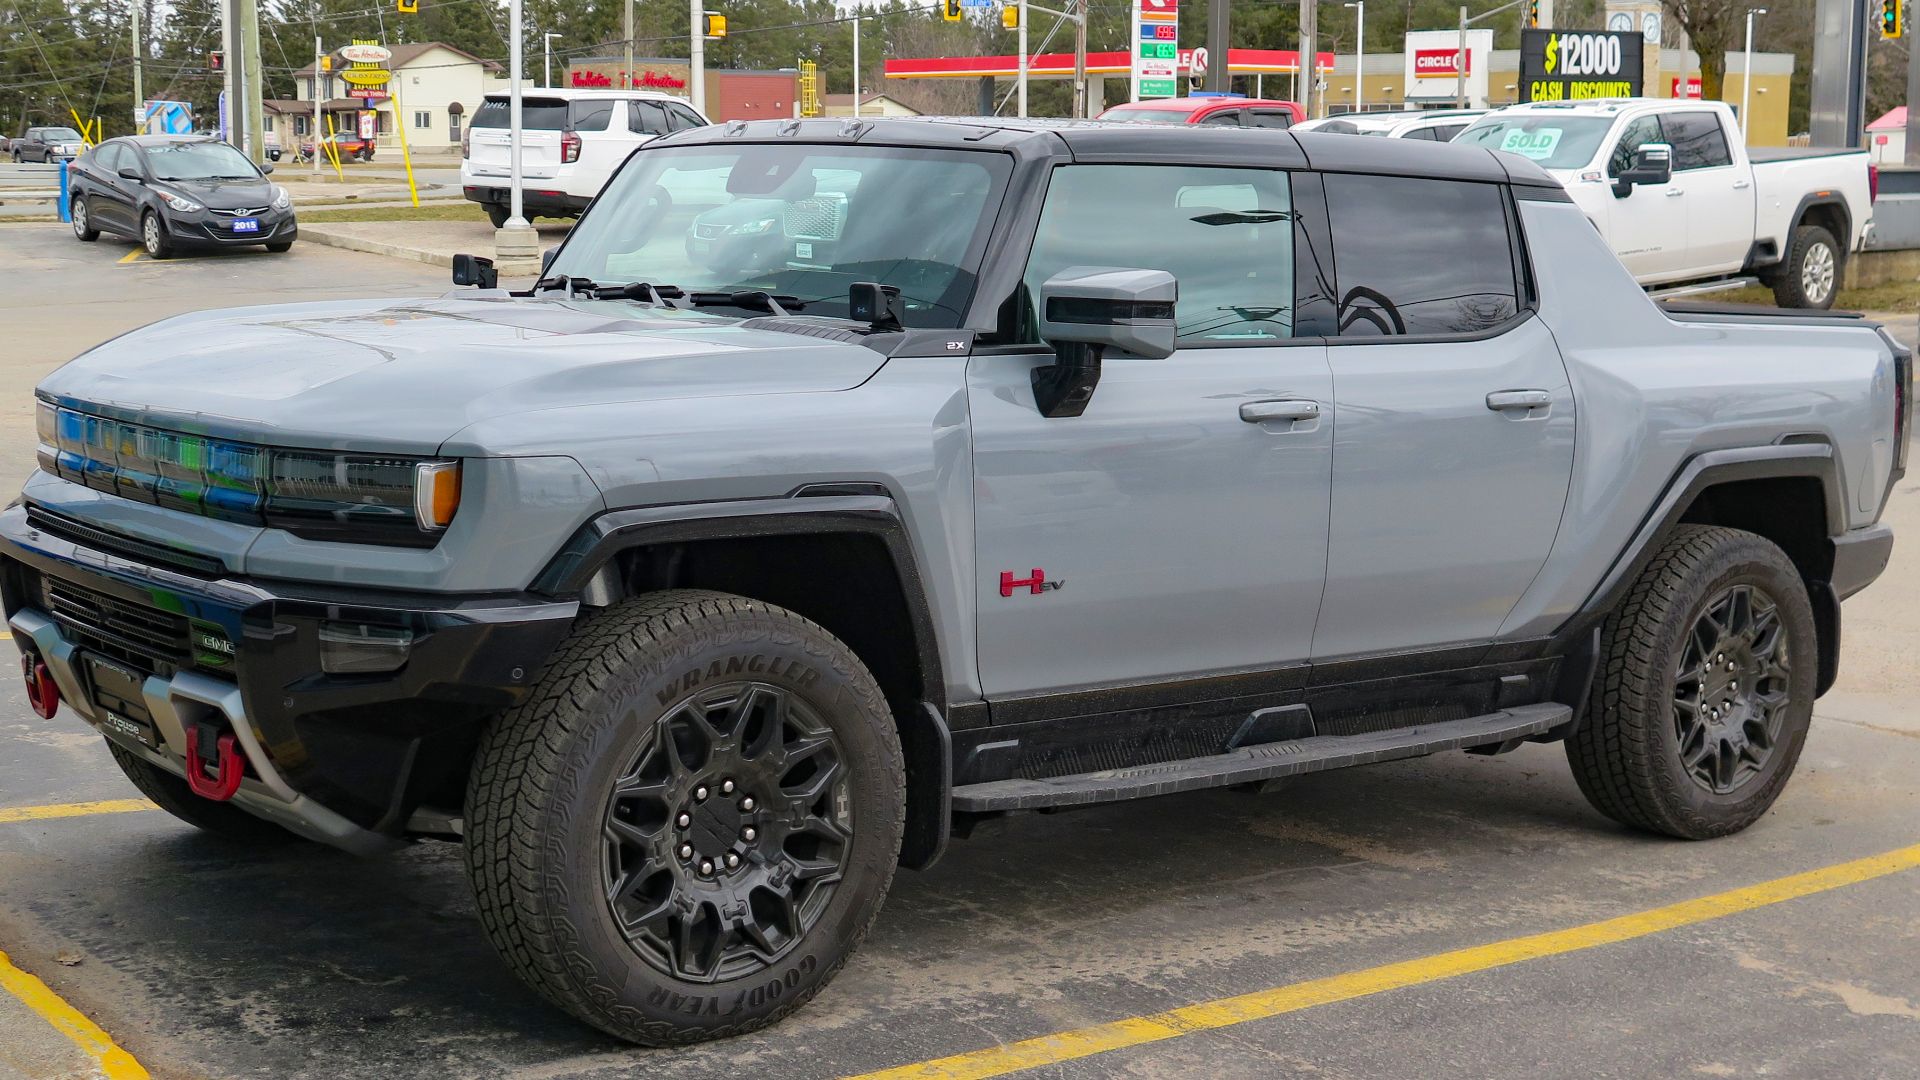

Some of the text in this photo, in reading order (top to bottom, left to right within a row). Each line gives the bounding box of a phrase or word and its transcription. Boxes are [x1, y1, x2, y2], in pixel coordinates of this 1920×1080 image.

[1417, 56, 1452, 68] CIRCLE
[1545, 33, 1621, 75] $12000
[1531, 81, 1631, 102] CASH DISCOUNTS
[1506, 135, 1553, 149] SOLD
[234, 221, 257, 229] 2015
[946, 341, 965, 350] 2X
[203, 635, 236, 654] GMC
[655, 654, 823, 708] WRANGLER
[107, 711, 140, 735] Prouse
